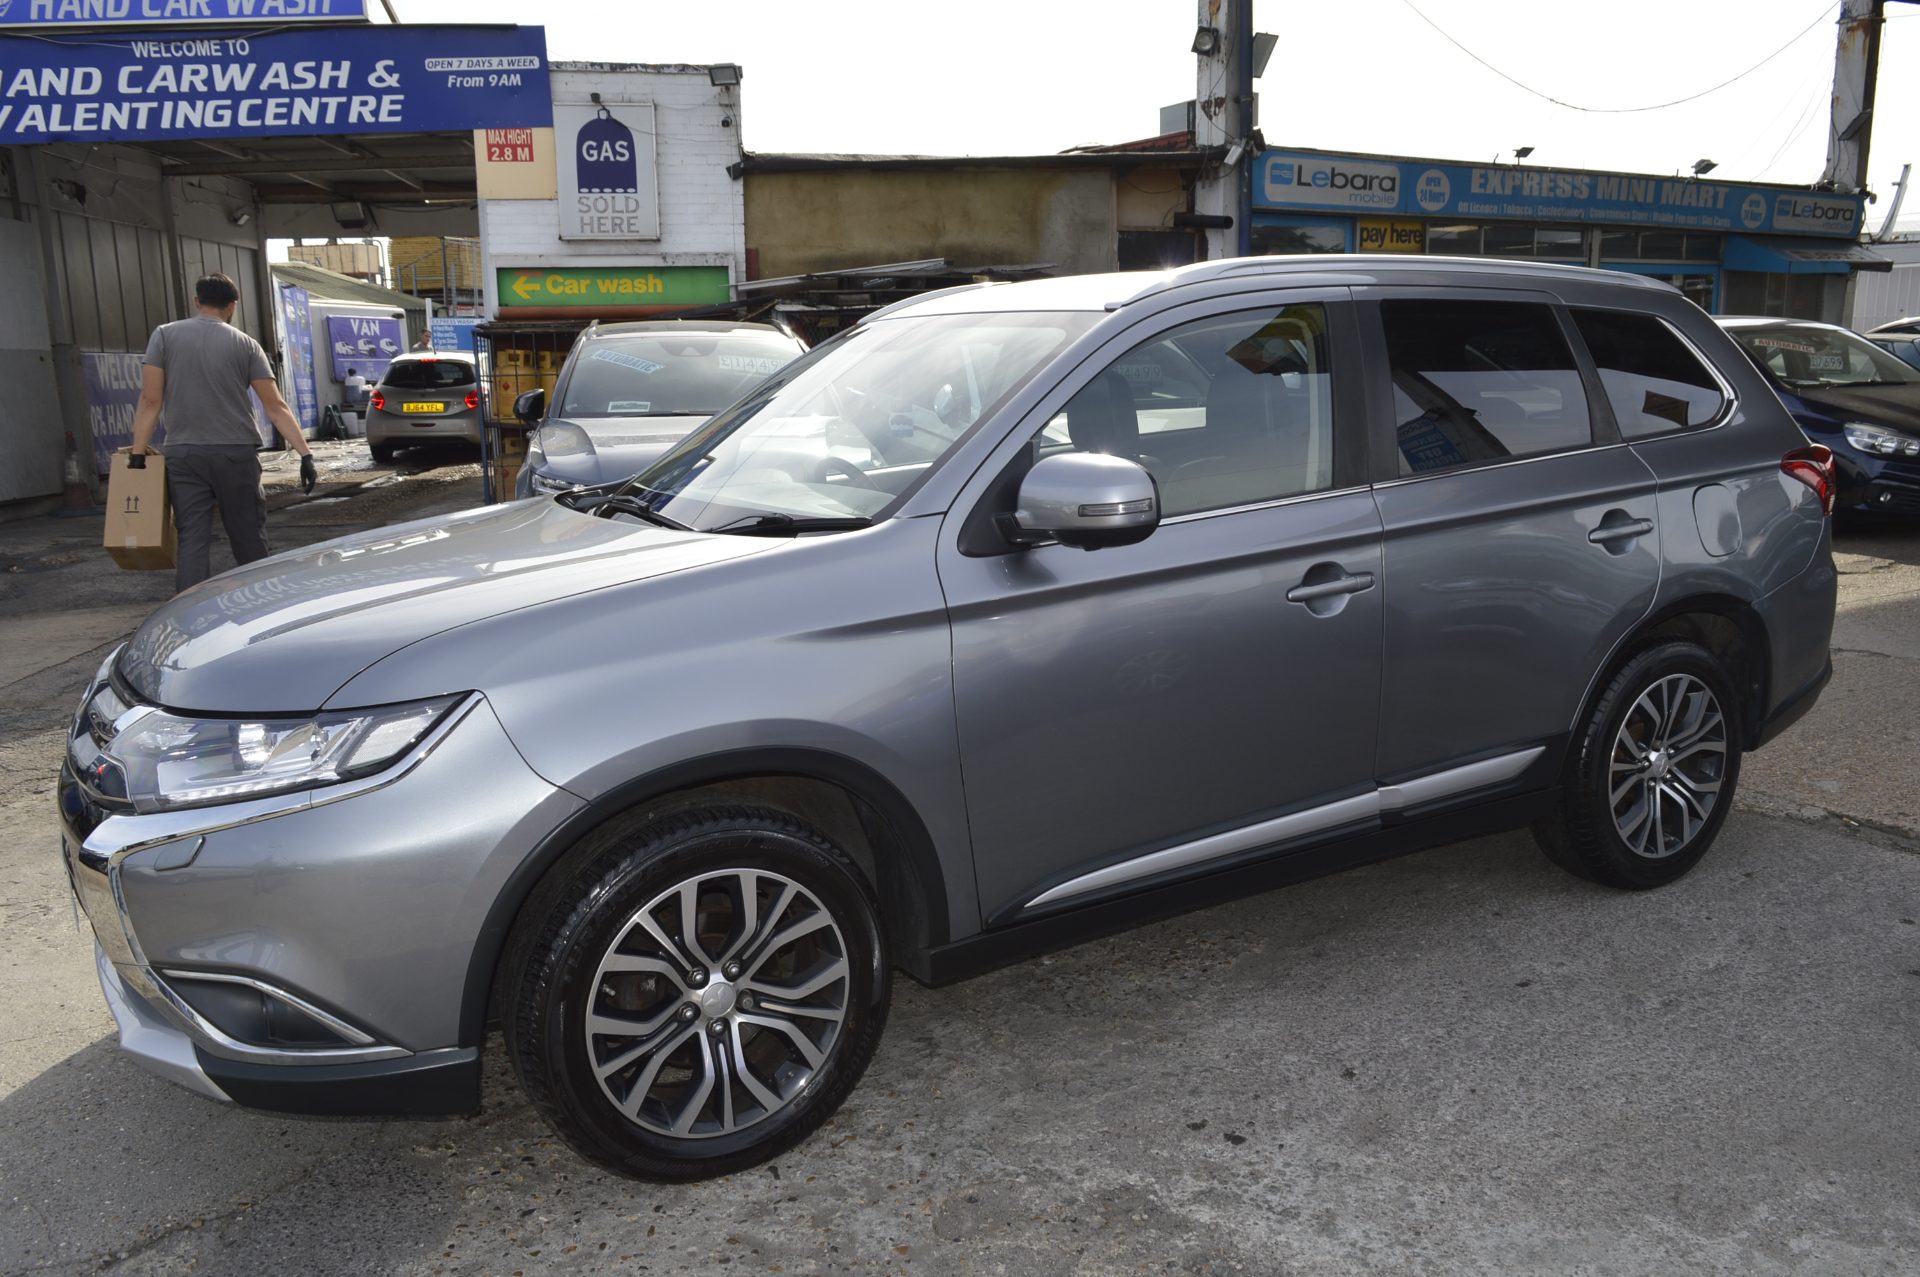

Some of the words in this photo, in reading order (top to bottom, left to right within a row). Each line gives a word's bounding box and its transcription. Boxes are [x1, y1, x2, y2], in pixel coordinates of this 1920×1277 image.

[30, 0, 130, 20] HAND
[141, 0, 211, 18] CAR
[131, 40, 222, 58] WELCOME
[228, 39, 250, 57] TO
[427, 60, 453, 70] OPEN
[457, 60, 463, 69] 7
[466, 59, 493, 68] DAYS
[497, 59, 504, 68] A
[507, 58, 536, 68] WEEK
[0, 66, 103, 97] AND
[367, 59, 401, 88] &
[447, 75, 484, 88] From
[488, 74, 522, 87] 9AM
[488, 129, 506, 145] MAX
[507, 129, 532, 145] HIGHT
[491, 147, 513, 161] 2.8
[517, 147, 530, 161] M
[582, 140, 630, 162] GAS
[1296, 164, 1397, 193] Lebara
[1471, 168, 1590, 199] EXPRESS
[1596, 175, 1657, 203] MINI
[1660, 180, 1730, 209] MART
[577, 195, 641, 214] SOLD
[1349, 192, 1395, 205] mobile
[1792, 200, 1854, 221] Lebara
[580, 216, 640, 234] HERE
[1360, 227, 1387, 249] pay
[1390, 222, 1422, 244] here
[545, 274, 591, 295] Car
[597, 273, 664, 294] wash
[350, 318, 381, 336] VAN
[599, 351, 656, 372] AUTOMATIC
[96, 354, 143, 391] WELCO
